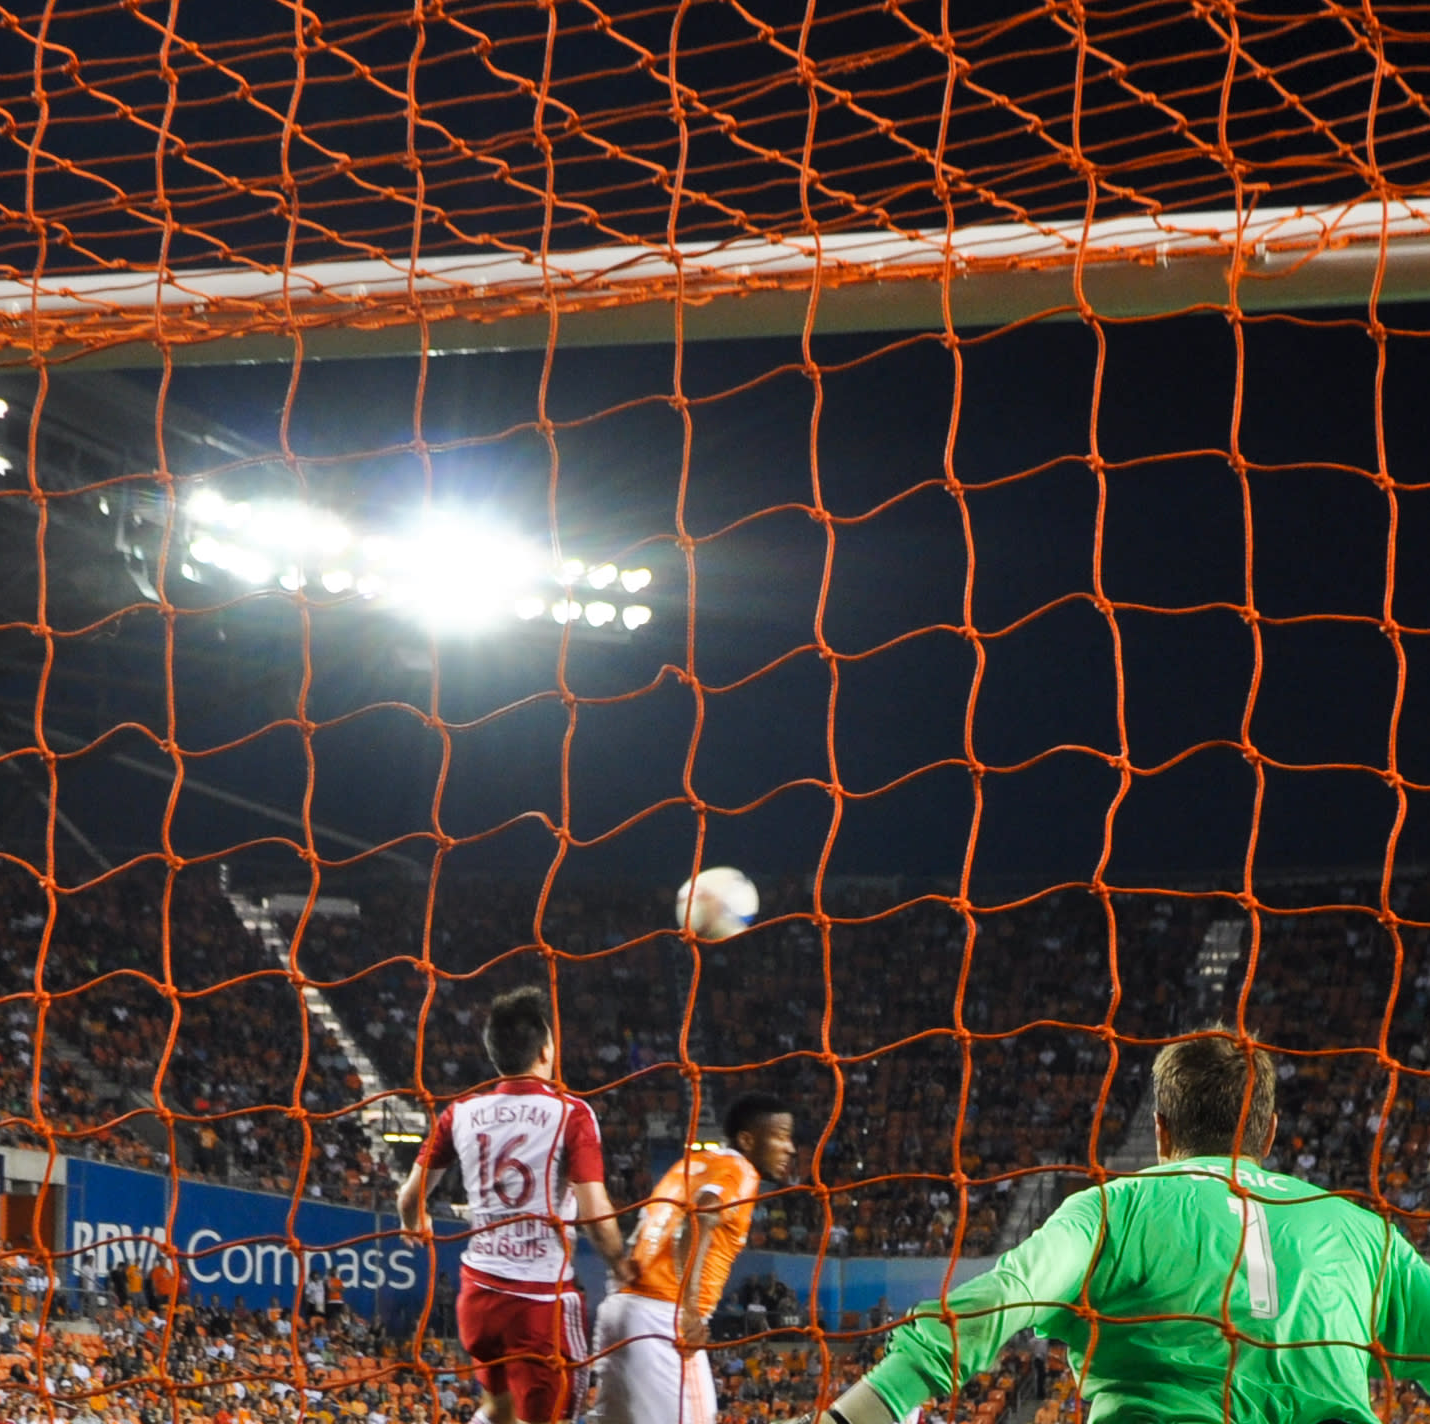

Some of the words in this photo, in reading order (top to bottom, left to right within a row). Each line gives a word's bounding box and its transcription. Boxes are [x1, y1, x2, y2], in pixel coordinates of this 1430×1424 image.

[476, 1132, 537, 1210] 16
[72, 1221, 173, 1279] BBVA
[187, 1229, 417, 1291] Compass
[1226, 1195, 1279, 1320] 1
